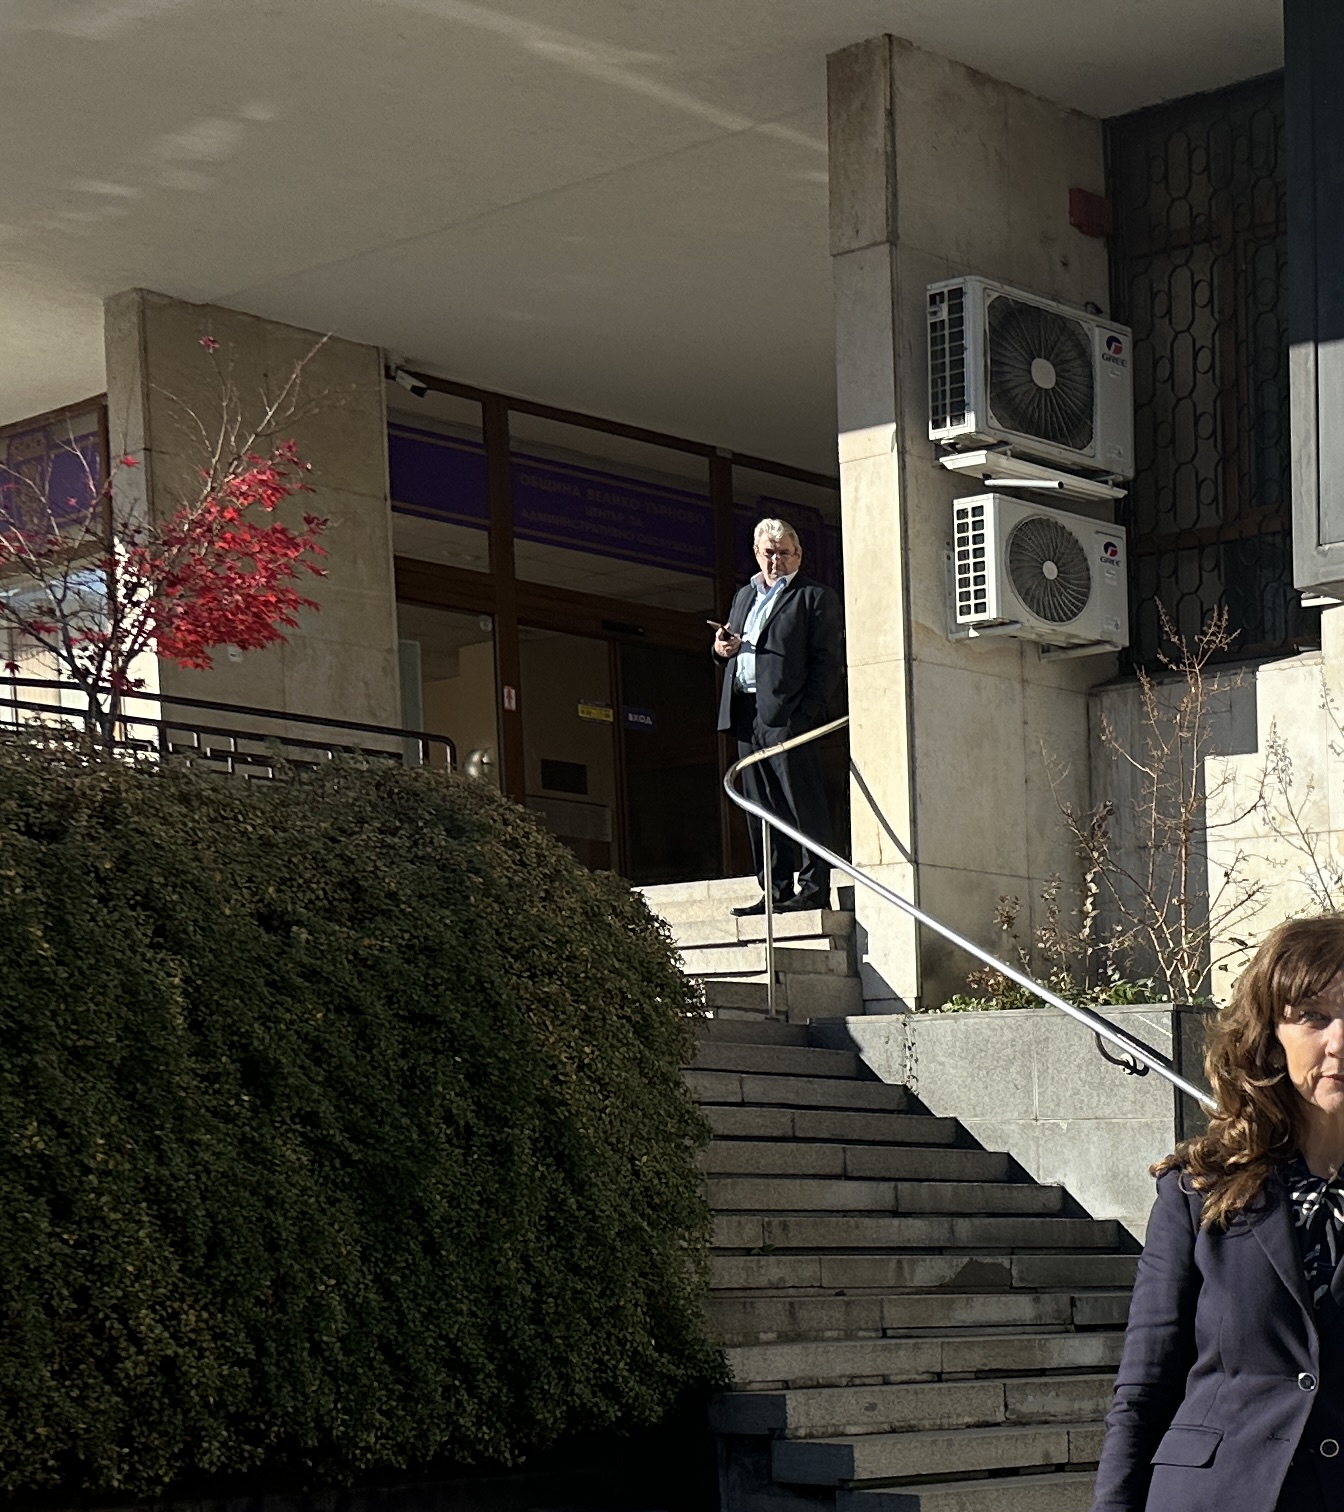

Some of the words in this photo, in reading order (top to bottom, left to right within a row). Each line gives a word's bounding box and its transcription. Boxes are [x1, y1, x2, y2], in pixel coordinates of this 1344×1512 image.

[1101, 353, 1128, 367] GREE
[519, 473, 582, 497] ОБЩИНА
[586, 488, 640, 510] ВЕЛИКО
[644, 501, 706, 526] ТЪРНОВО
[628, 713, 652, 725] ВХОД
